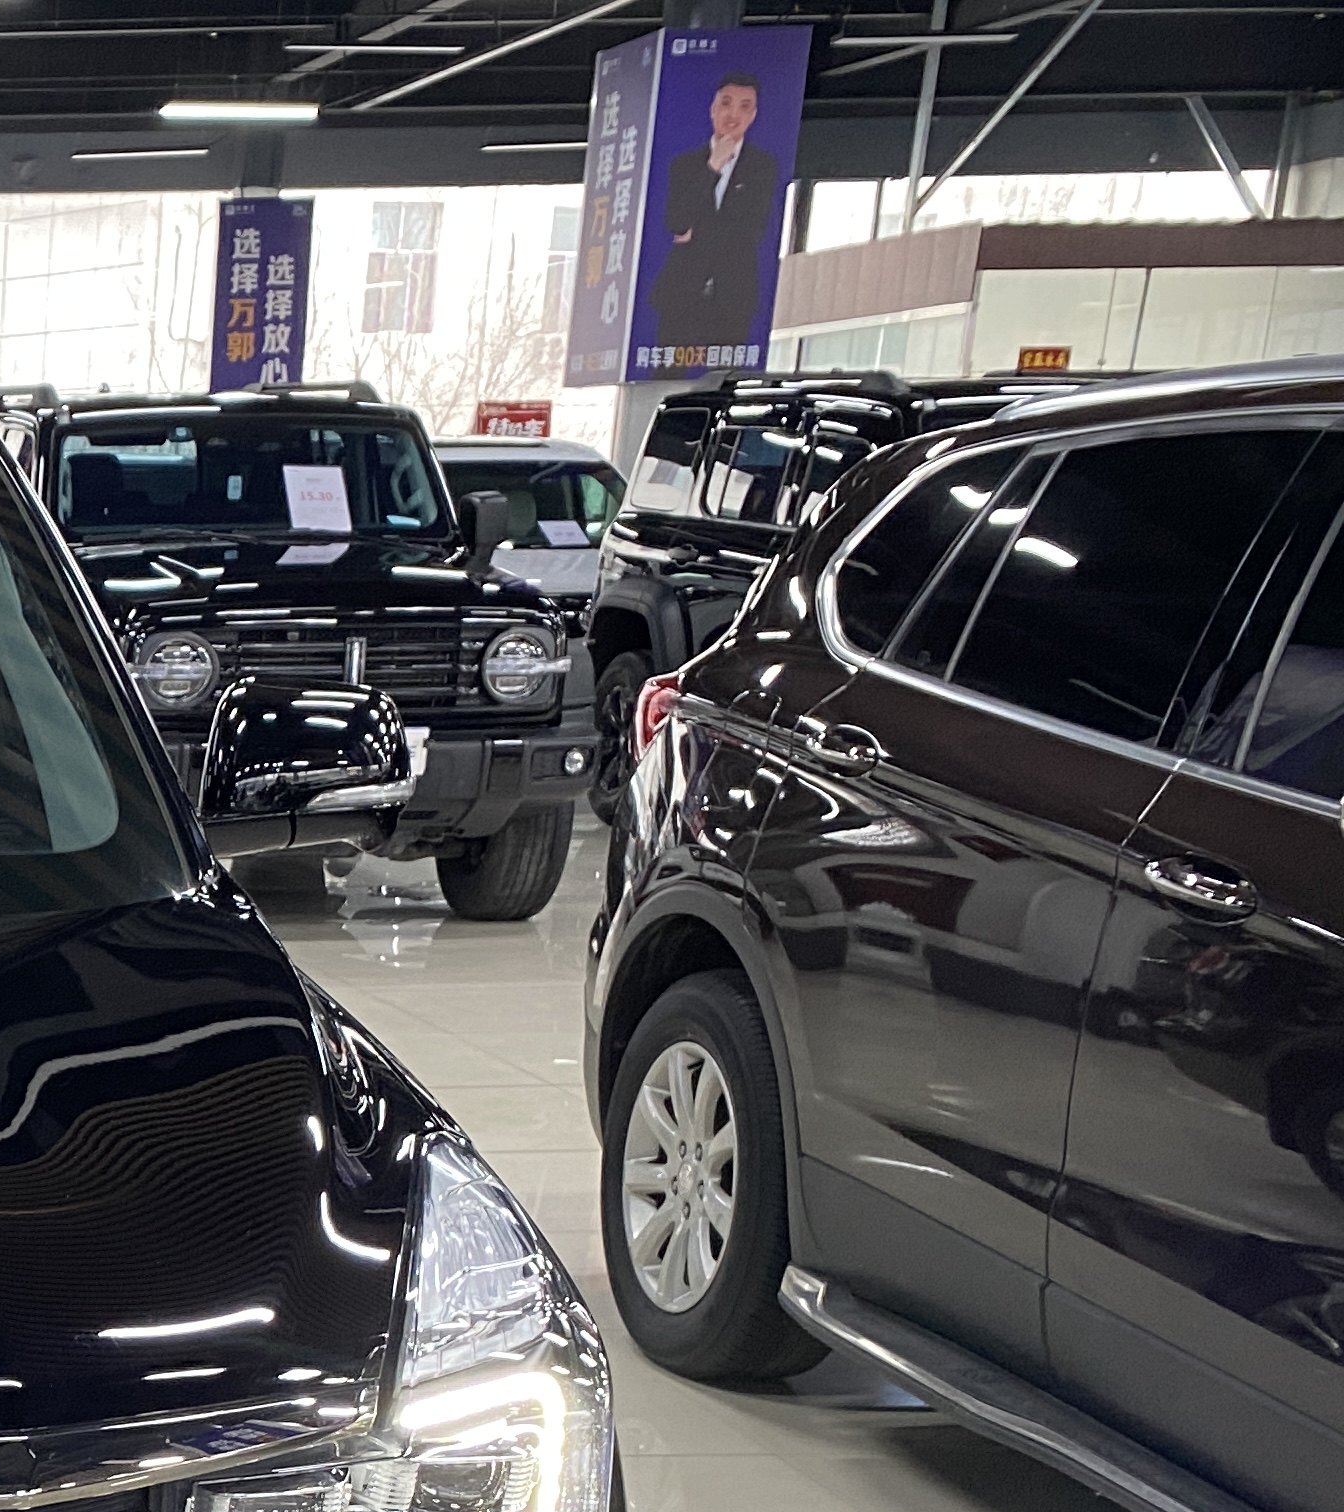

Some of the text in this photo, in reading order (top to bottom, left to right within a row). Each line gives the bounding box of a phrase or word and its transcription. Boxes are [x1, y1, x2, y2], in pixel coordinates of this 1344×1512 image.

[225, 227, 260, 362] 选择万郭
[260, 254, 295, 385] 选择放心
